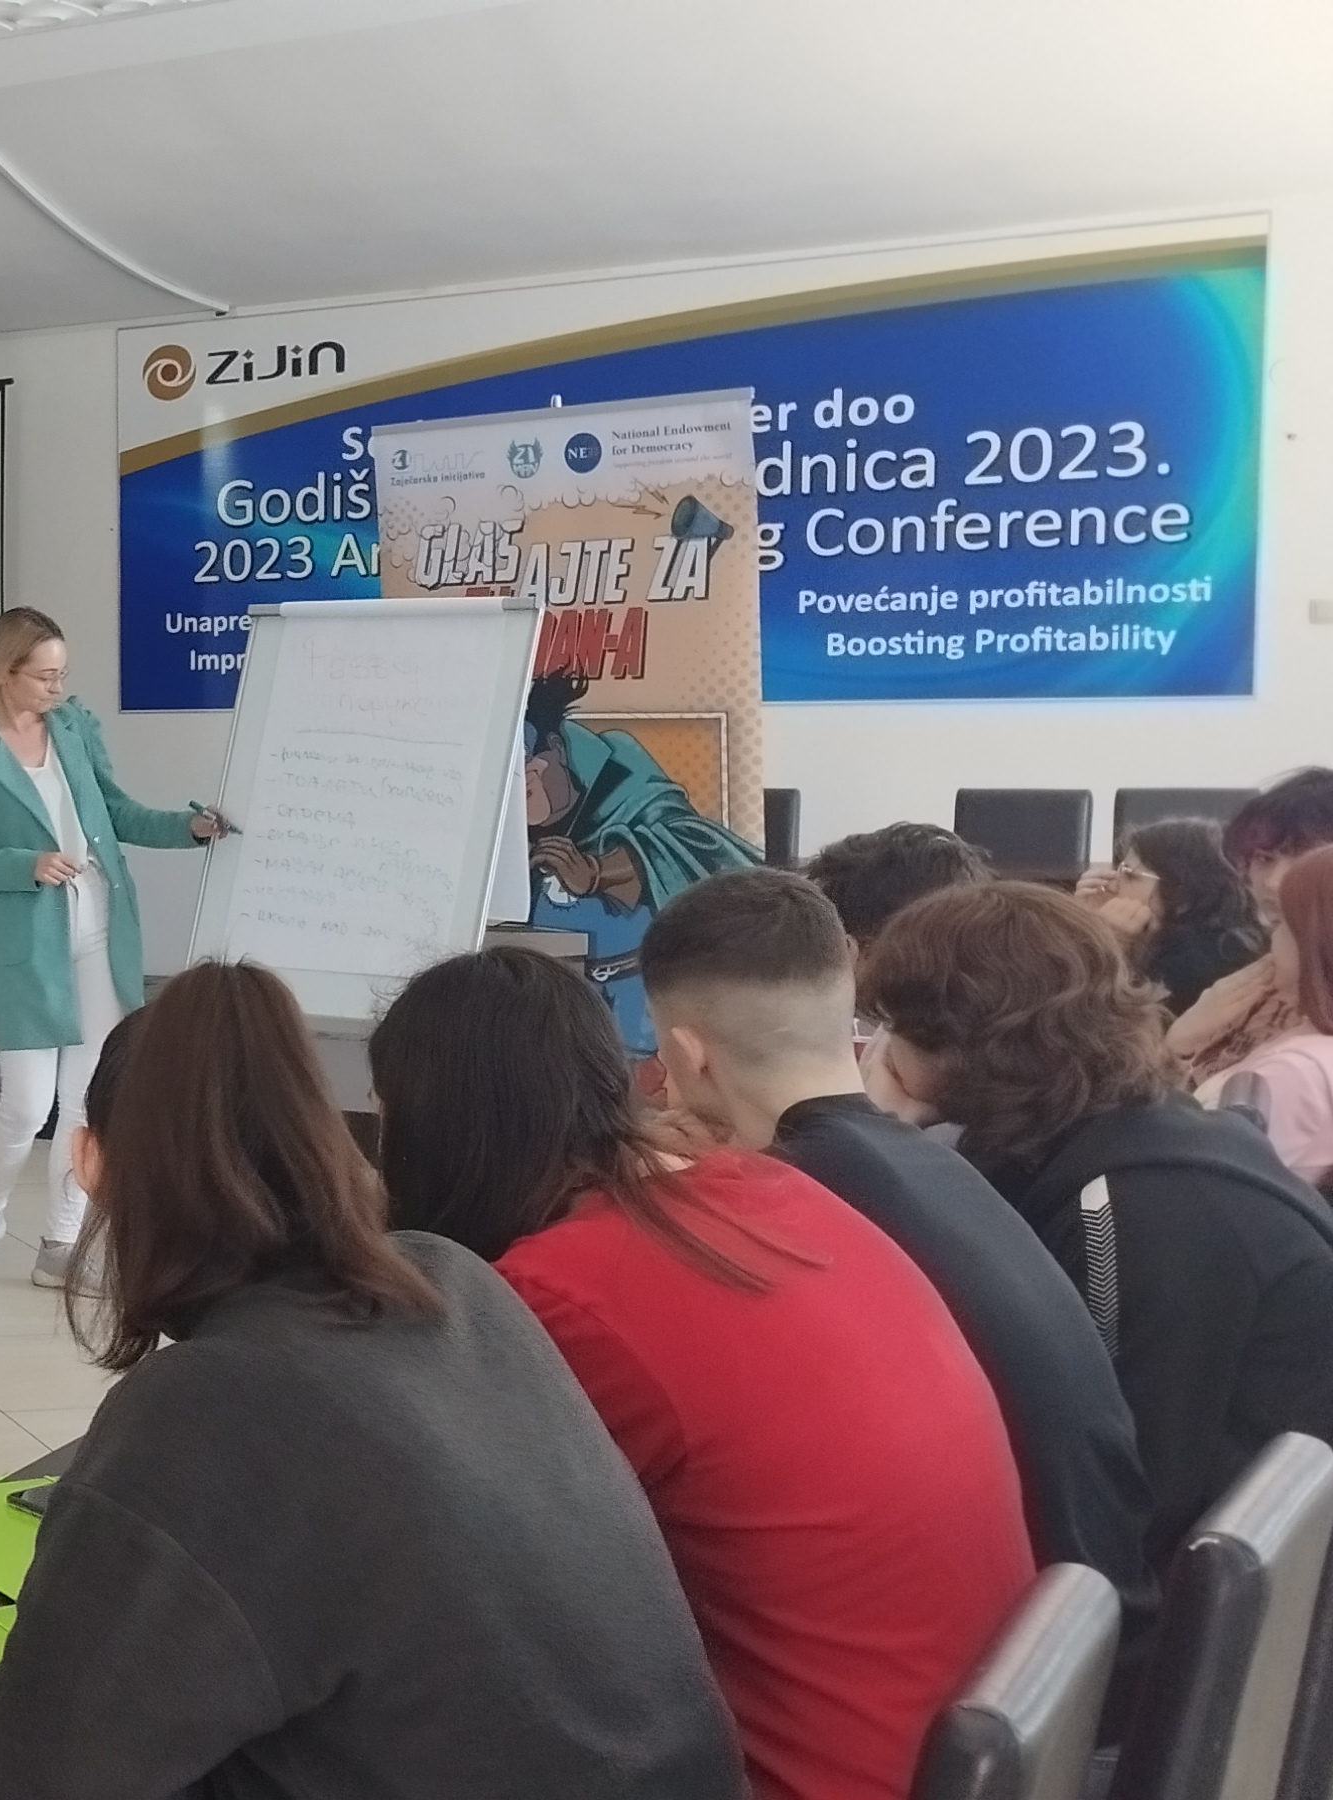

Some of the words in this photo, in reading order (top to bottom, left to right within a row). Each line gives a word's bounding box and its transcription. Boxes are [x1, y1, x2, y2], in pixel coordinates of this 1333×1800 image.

[814, 387, 915, 429] doo
[612, 426, 660, 441] National
[664, 421, 732, 437] Endowment
[612, 445, 627, 457] for
[632, 441, 695, 456] Democracy
[217, 468, 371, 526] Godiš
[964, 420, 1171, 486] 2023.
[194, 536, 314, 583] 2023
[806, 499, 1191, 557] Conference
[798, 585, 959, 616] Povećanje
[969, 576, 1213, 616] profitabilnosti
[827, 629, 965, 660] Boosting
[975, 624, 1177, 655] Profitability
